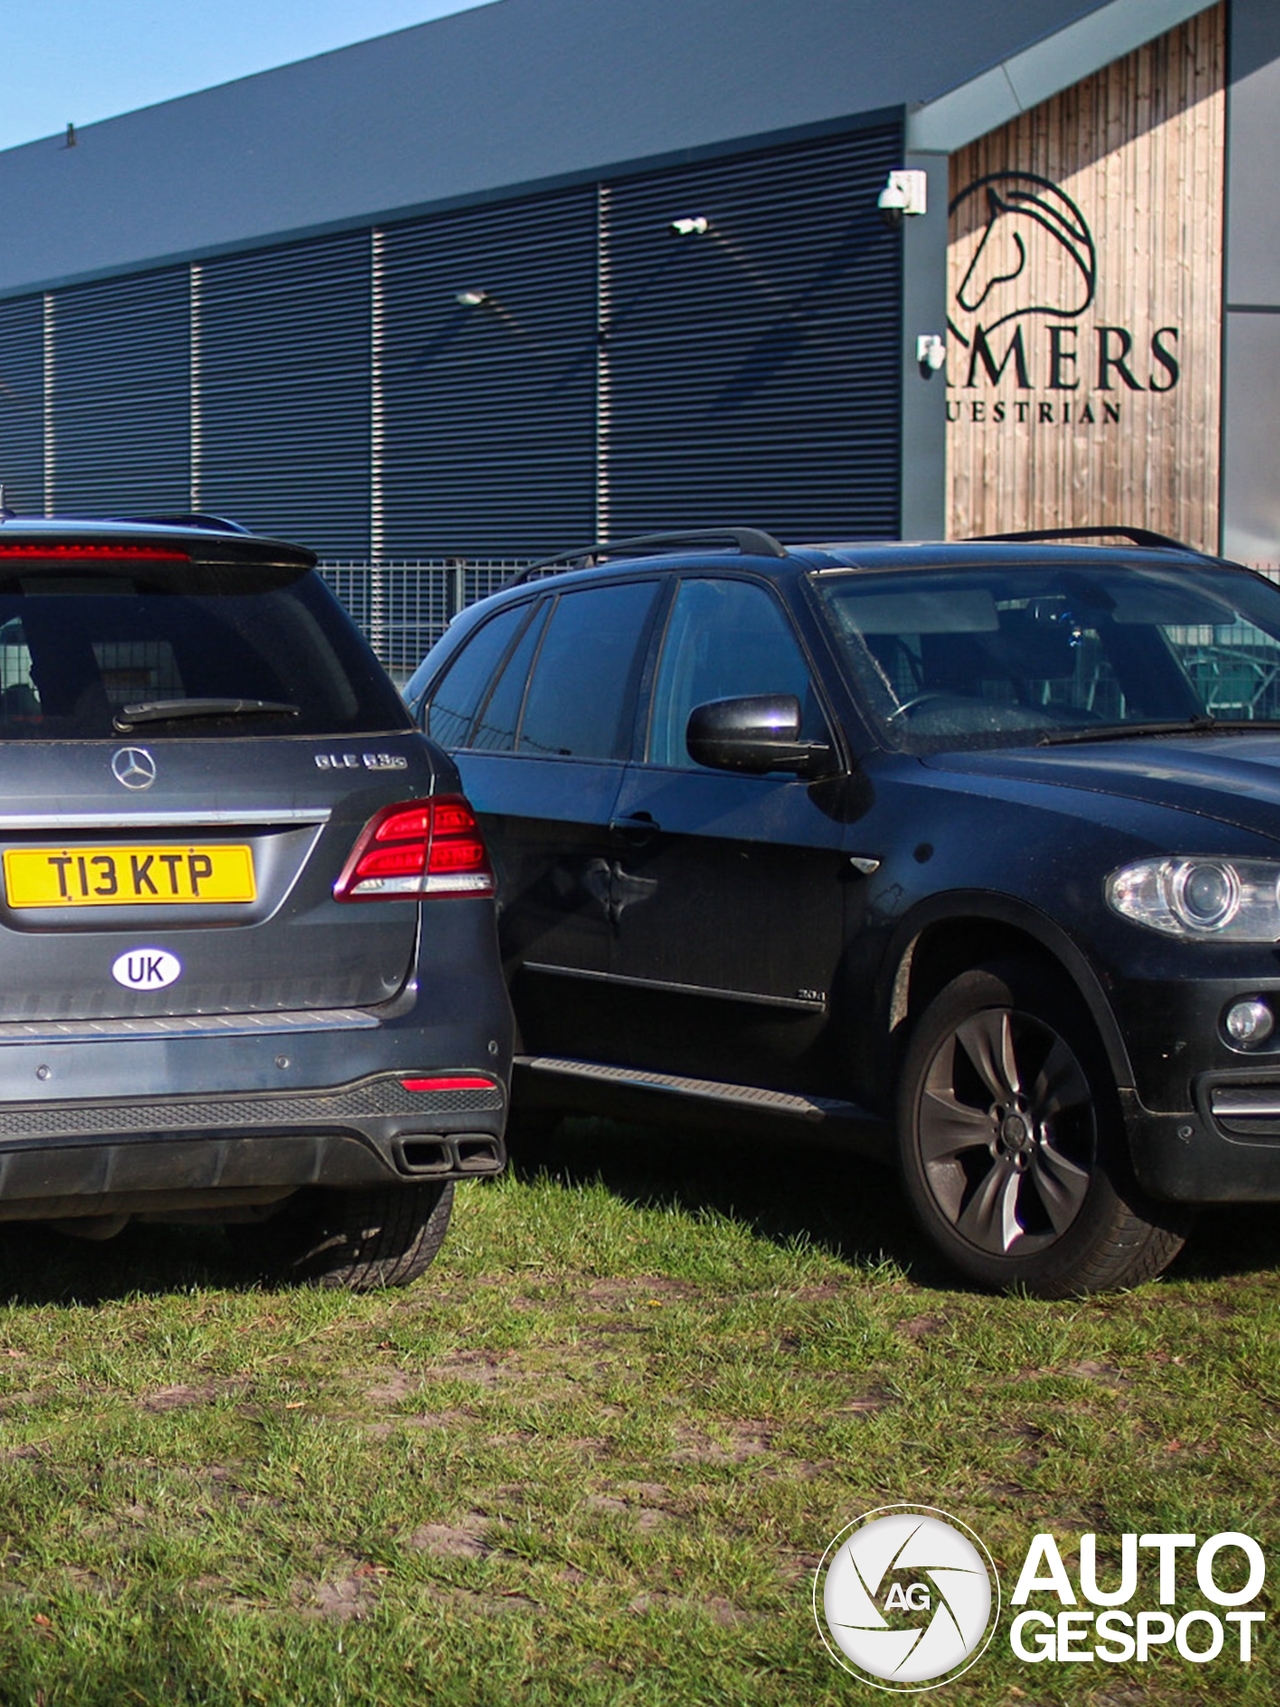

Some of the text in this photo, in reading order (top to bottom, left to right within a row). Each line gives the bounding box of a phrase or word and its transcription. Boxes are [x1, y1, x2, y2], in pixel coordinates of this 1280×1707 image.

[946, 323, 1179, 392] MERS
[314, 754, 359, 770] GLE
[48, 854, 213, 897] T13 KTP
[127, 956, 164, 982] UK
